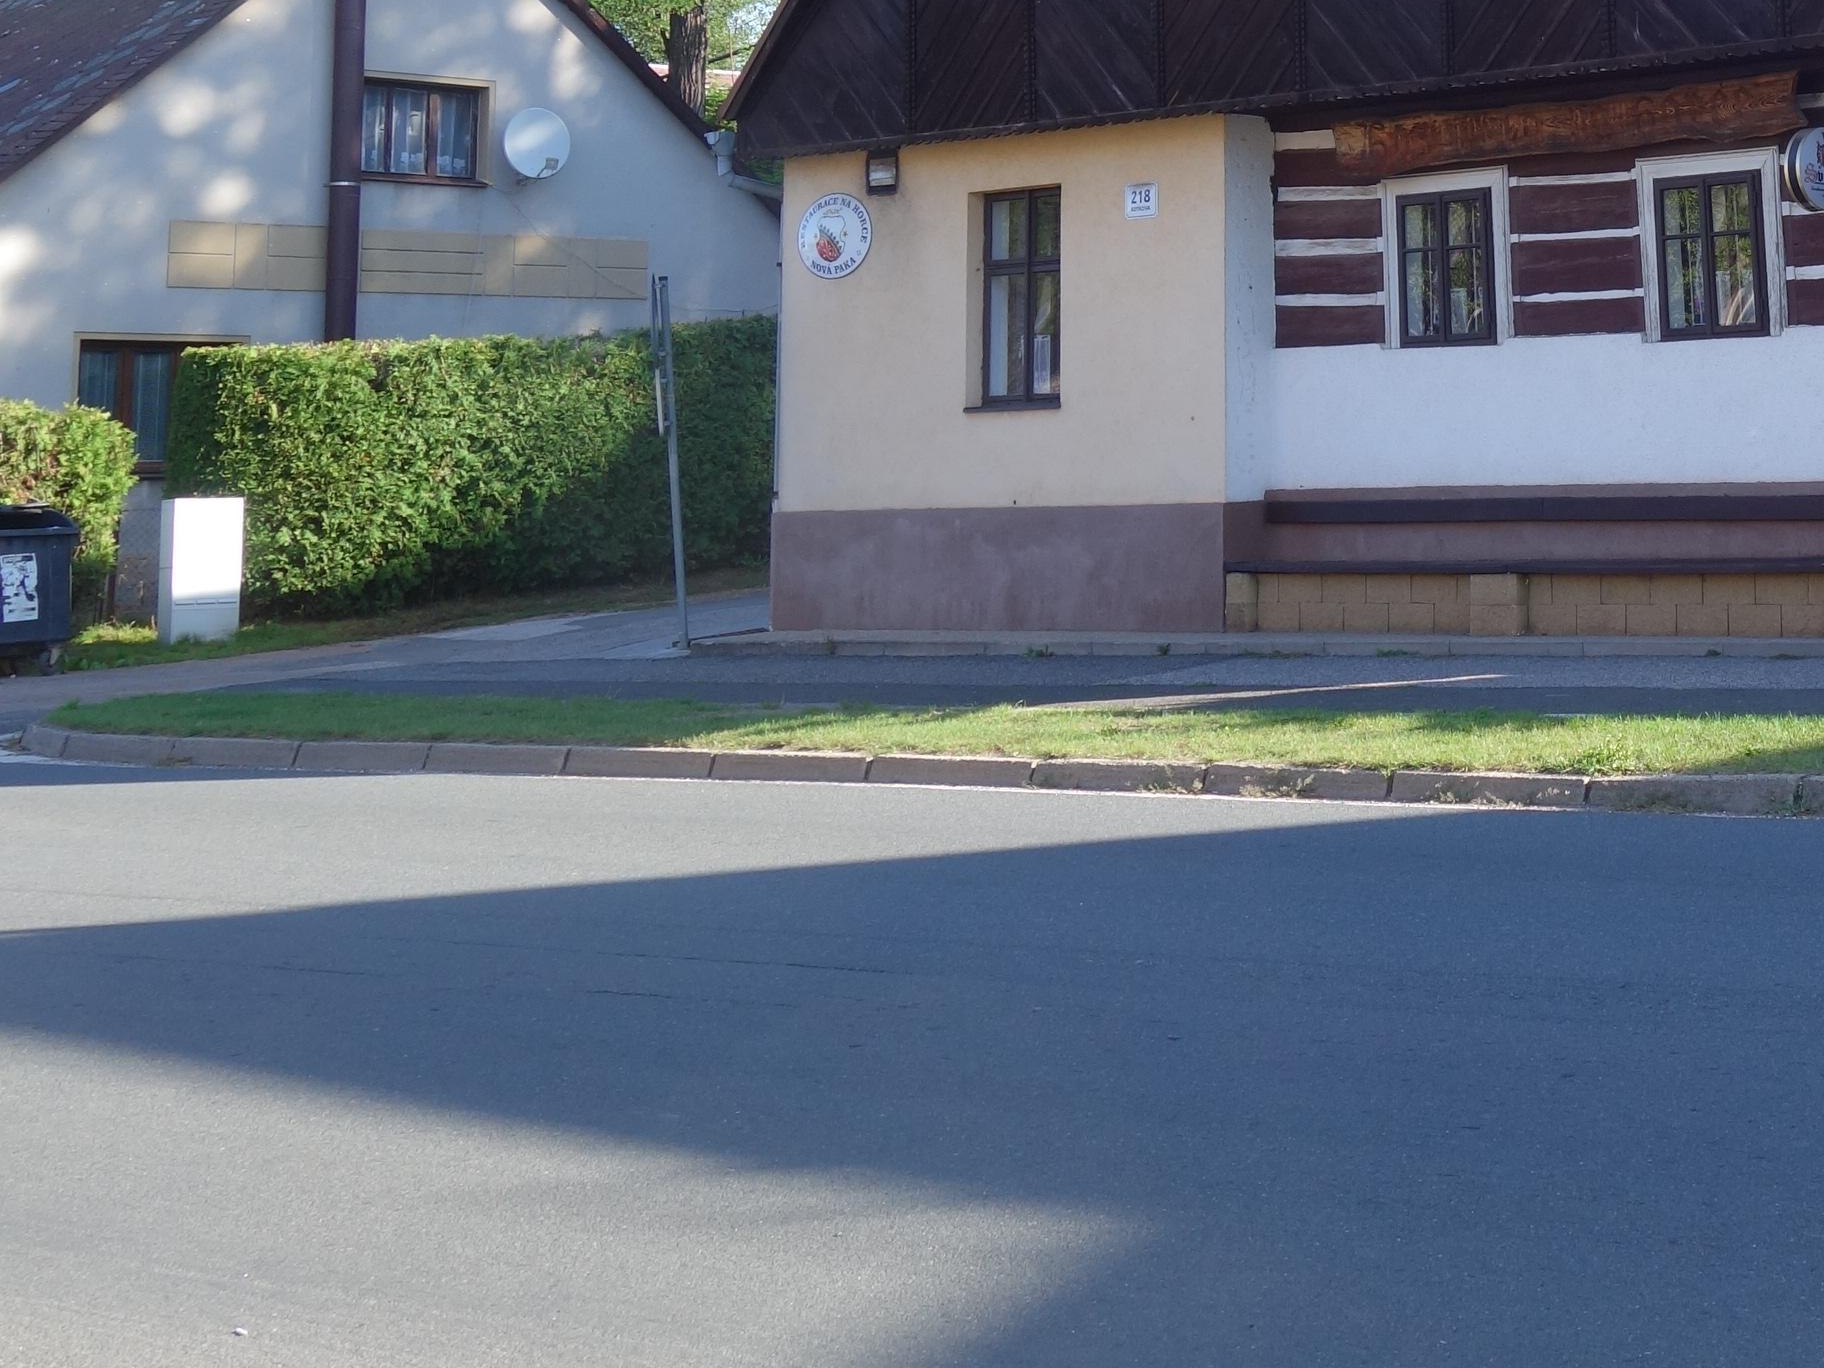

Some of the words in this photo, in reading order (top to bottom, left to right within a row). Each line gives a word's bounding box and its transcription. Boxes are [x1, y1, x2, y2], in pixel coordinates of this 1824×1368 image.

[840, 197, 852, 209] NA
[1131, 189, 1151, 204] 218
[810, 259, 832, 275] NOVÁ
[834, 256, 856, 274] PAKA
